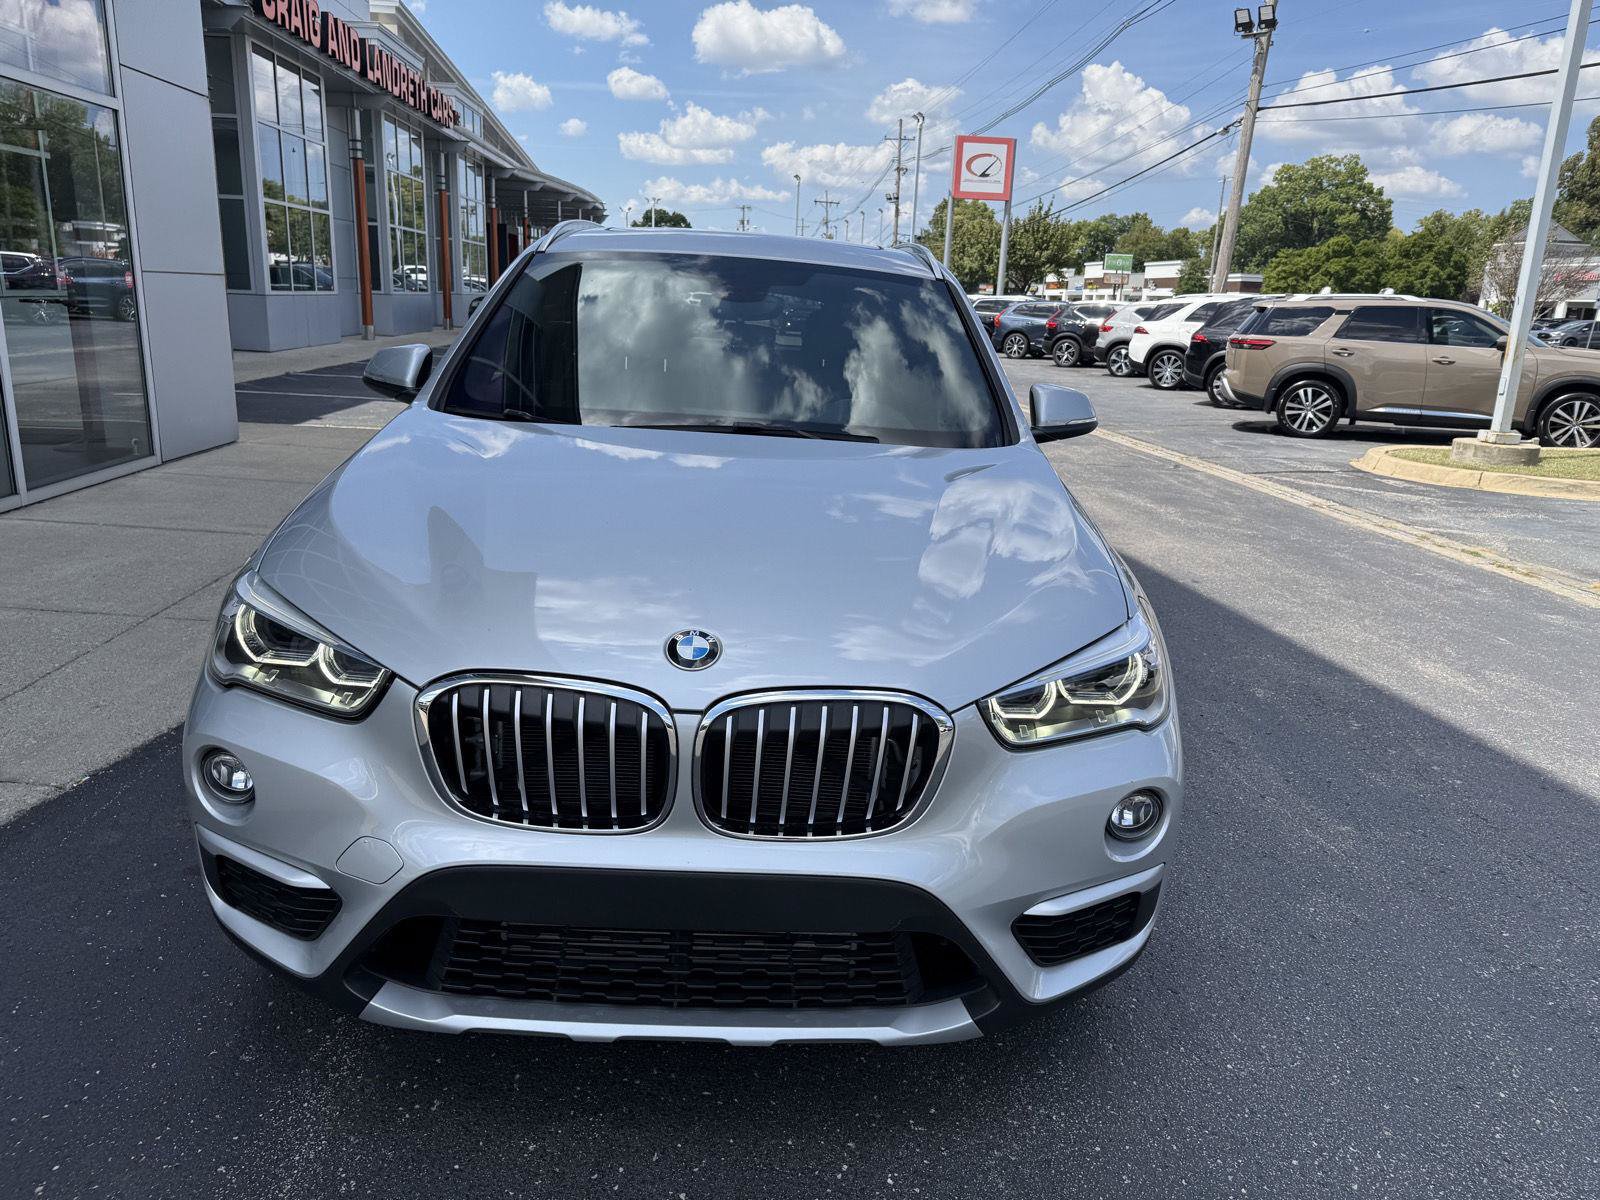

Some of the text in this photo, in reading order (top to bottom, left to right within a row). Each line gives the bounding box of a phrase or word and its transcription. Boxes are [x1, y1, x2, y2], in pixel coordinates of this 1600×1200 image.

[328, 12, 361, 73] AND
[365, 38, 428, 115] LANDRETH
[430, 86, 454, 129] CARS
[674, 630, 716, 643] BMW
